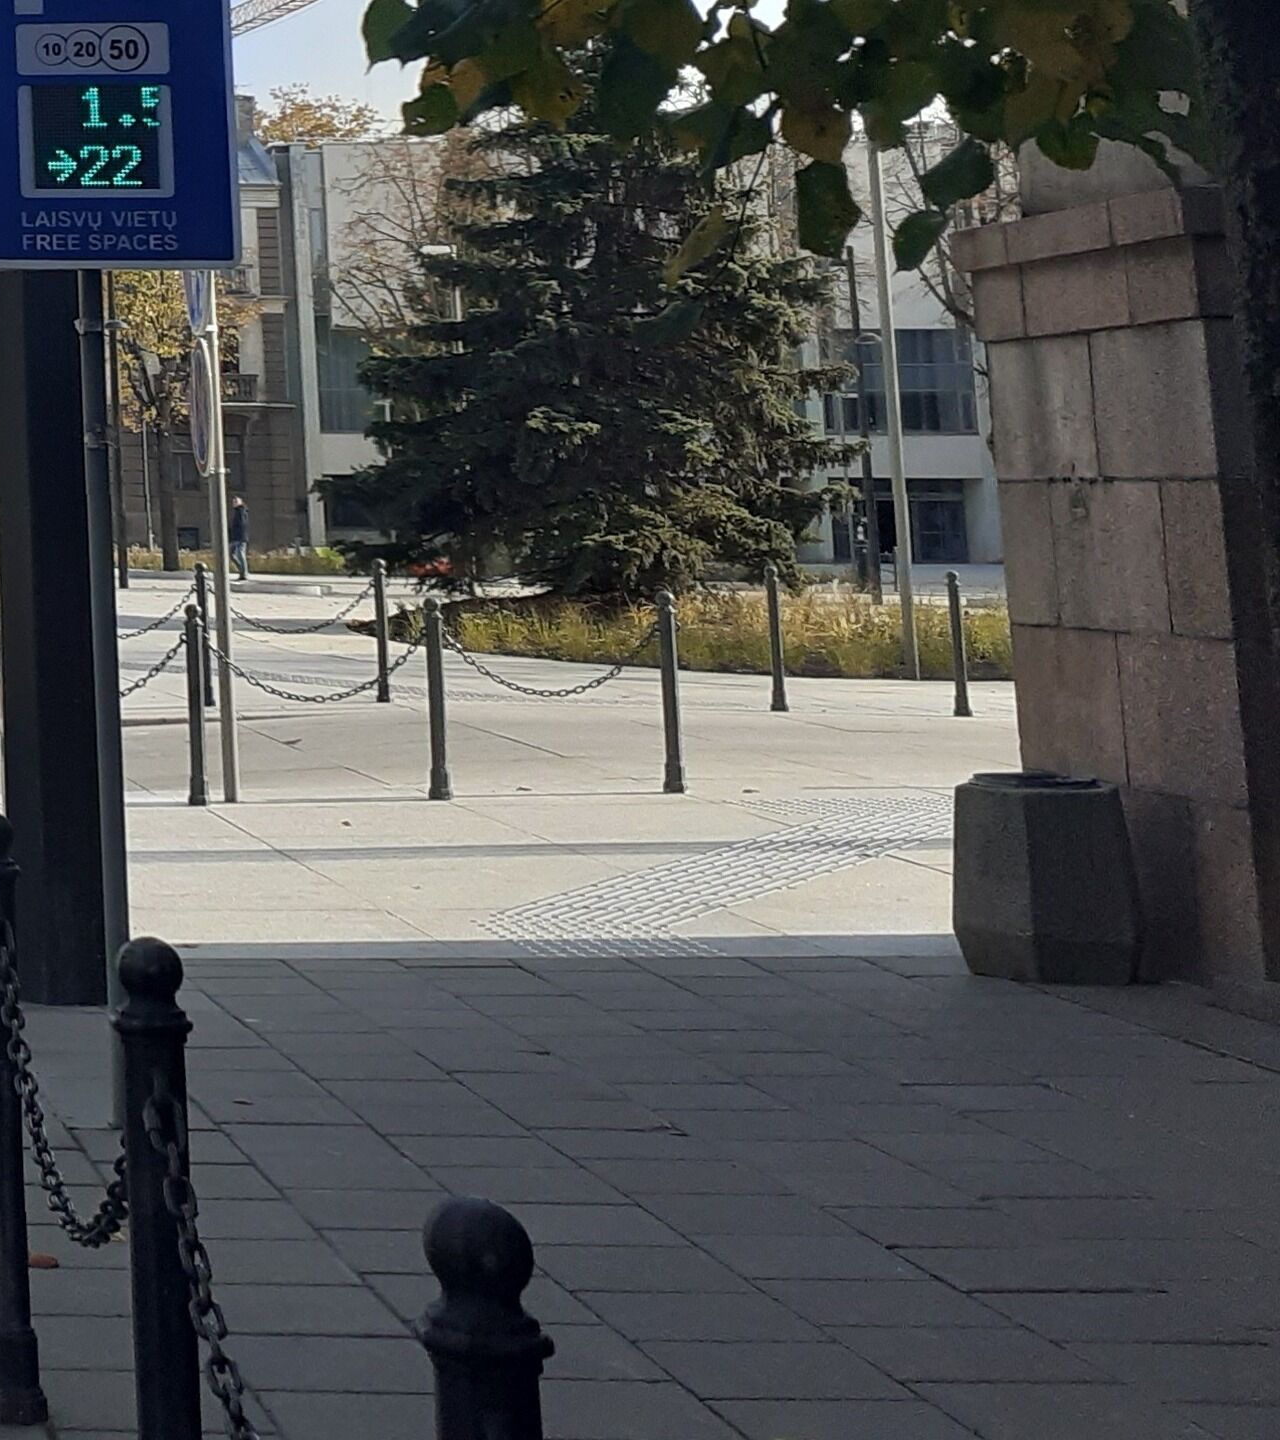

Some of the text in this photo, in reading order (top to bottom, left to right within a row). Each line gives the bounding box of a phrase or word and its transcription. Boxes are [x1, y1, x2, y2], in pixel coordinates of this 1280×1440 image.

[42, 39, 139, 60] 10 20 50
[80, 145, 143, 185] 22
[21, 211, 178, 231] LAISVŲ VIETŲ
[22, 234, 179, 251] FREE SPACES
